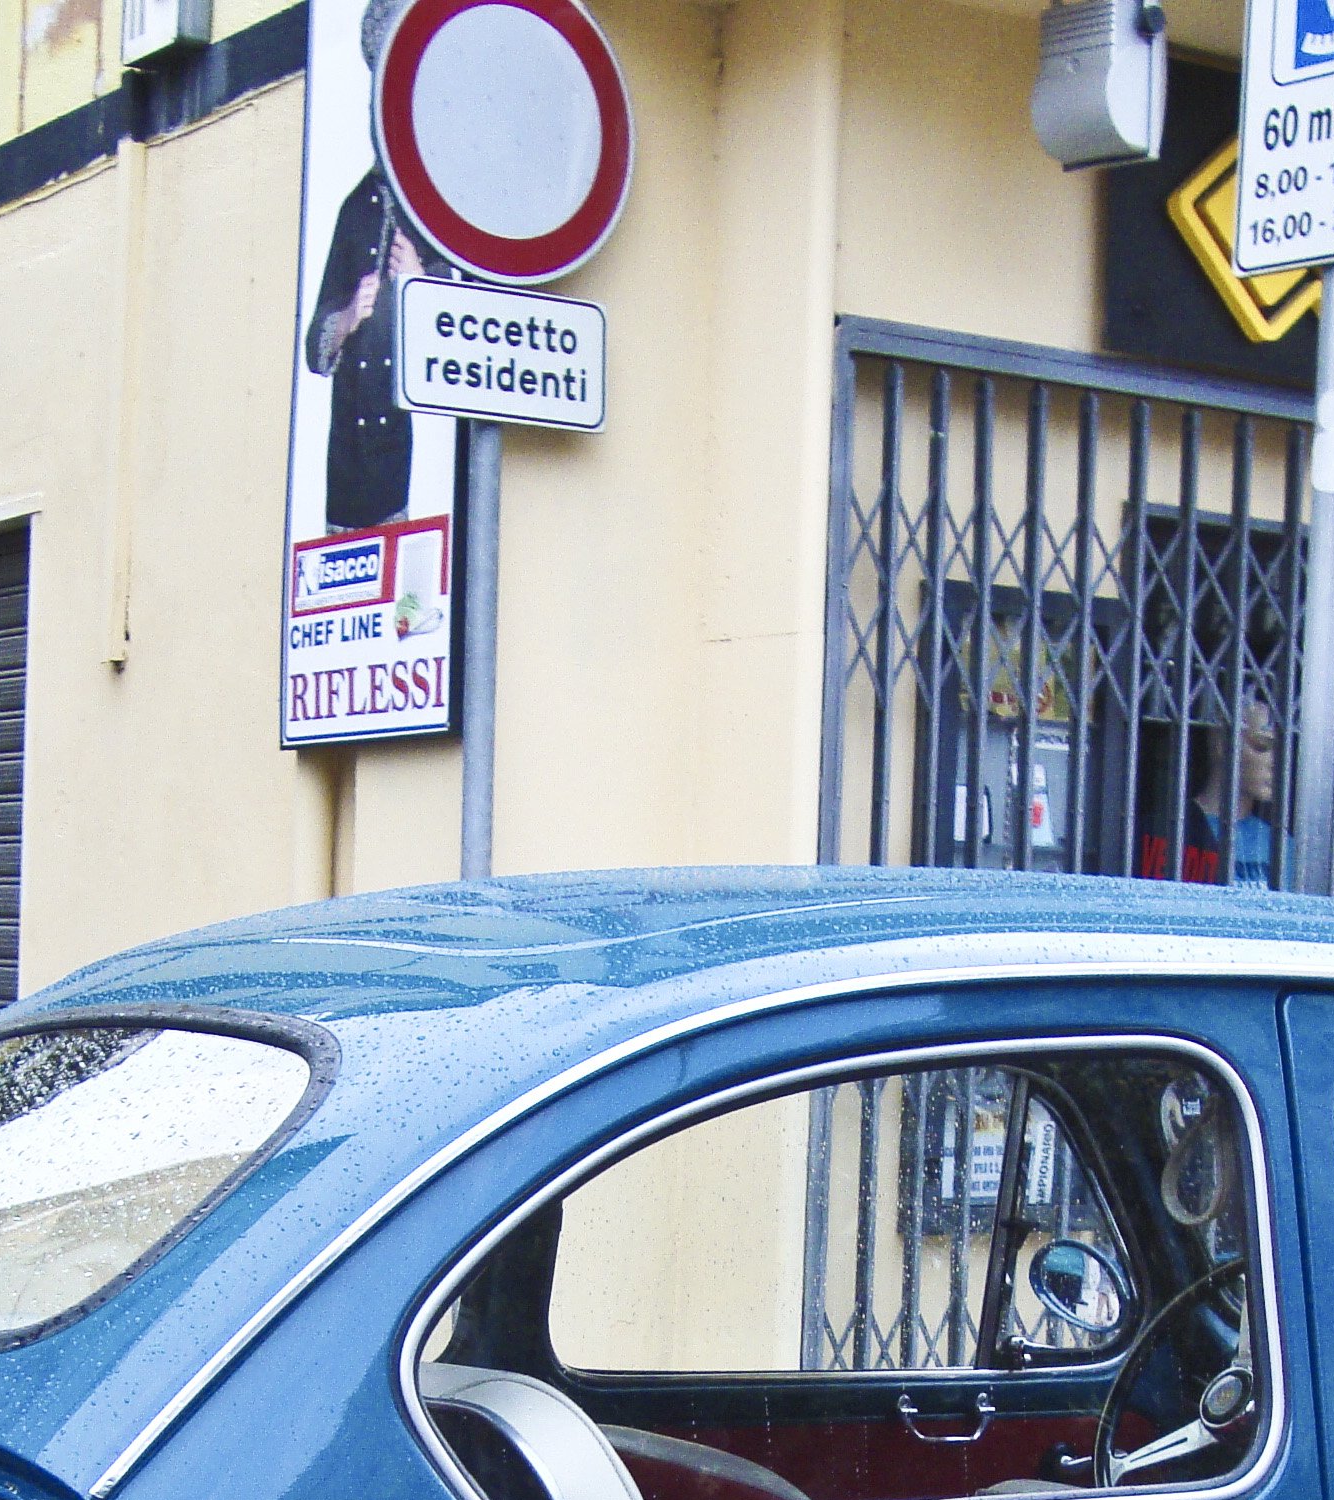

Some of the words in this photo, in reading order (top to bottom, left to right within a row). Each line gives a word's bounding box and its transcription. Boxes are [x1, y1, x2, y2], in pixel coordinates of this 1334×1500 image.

[1263, 104, 1299, 151] 60
[435, 311, 577, 355] eccetto
[425, 355, 587, 402] residenti
[290, 619, 335, 649] CHEF
[341, 612, 383, 643] LINE
[289, 656, 446, 721] RIFLESSI
